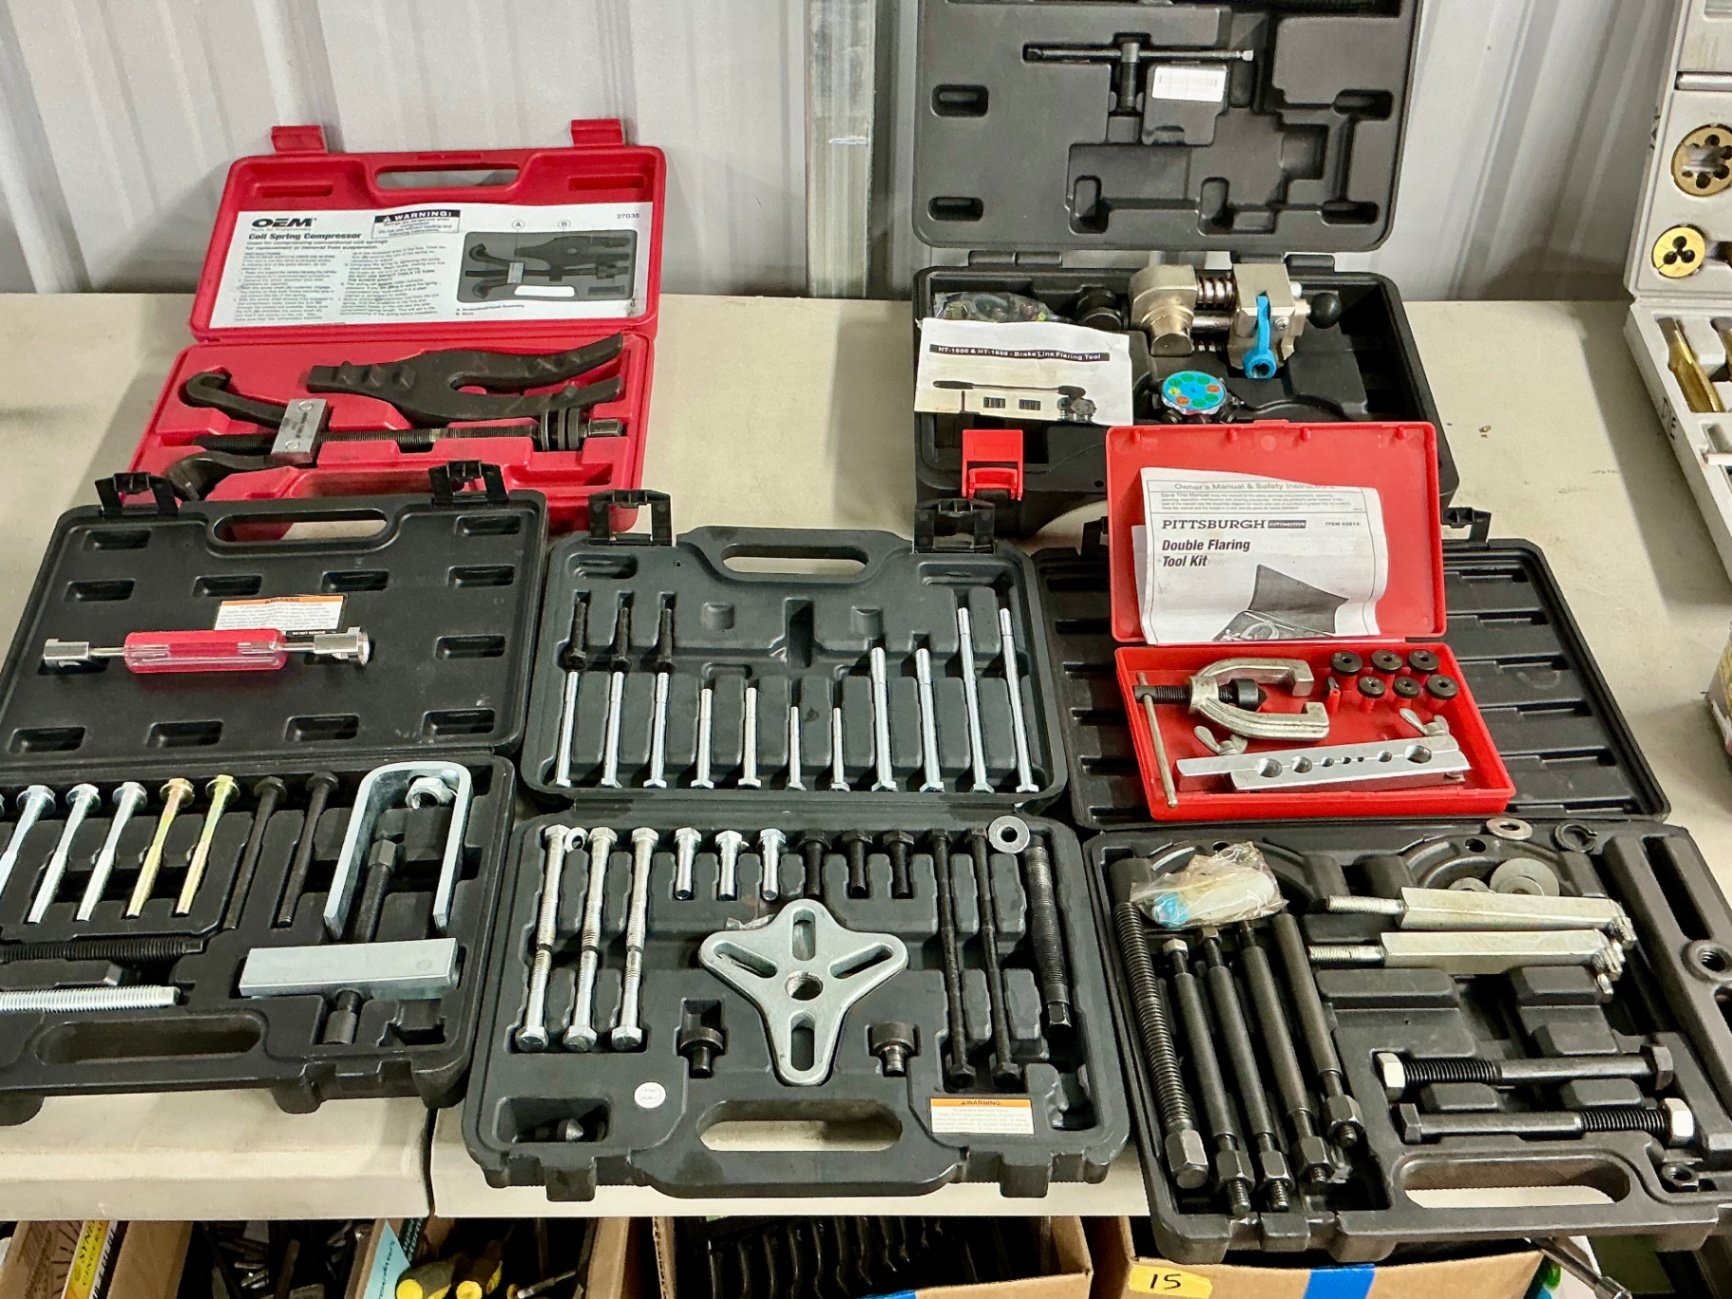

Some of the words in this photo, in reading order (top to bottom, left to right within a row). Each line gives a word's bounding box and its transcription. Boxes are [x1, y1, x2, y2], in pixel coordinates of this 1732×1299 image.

[252, 218, 312, 228] OEM
[270, 233, 301, 241] Spring
[304, 233, 362, 241] Compressor
[1055, 351, 1083, 361] Flaring
[1212, 482, 1244, 490] Manual
[1256, 482, 1283, 491] Safety
[1162, 519, 1265, 529] PITTSBURGH
[1162, 539, 1204, 551] Double
[1207, 539, 1251, 552] Flaring
[1163, 555, 1187, 567] Tool
[1189, 555, 1208, 567] Kit
[1150, 1273, 1181, 1290] 15
